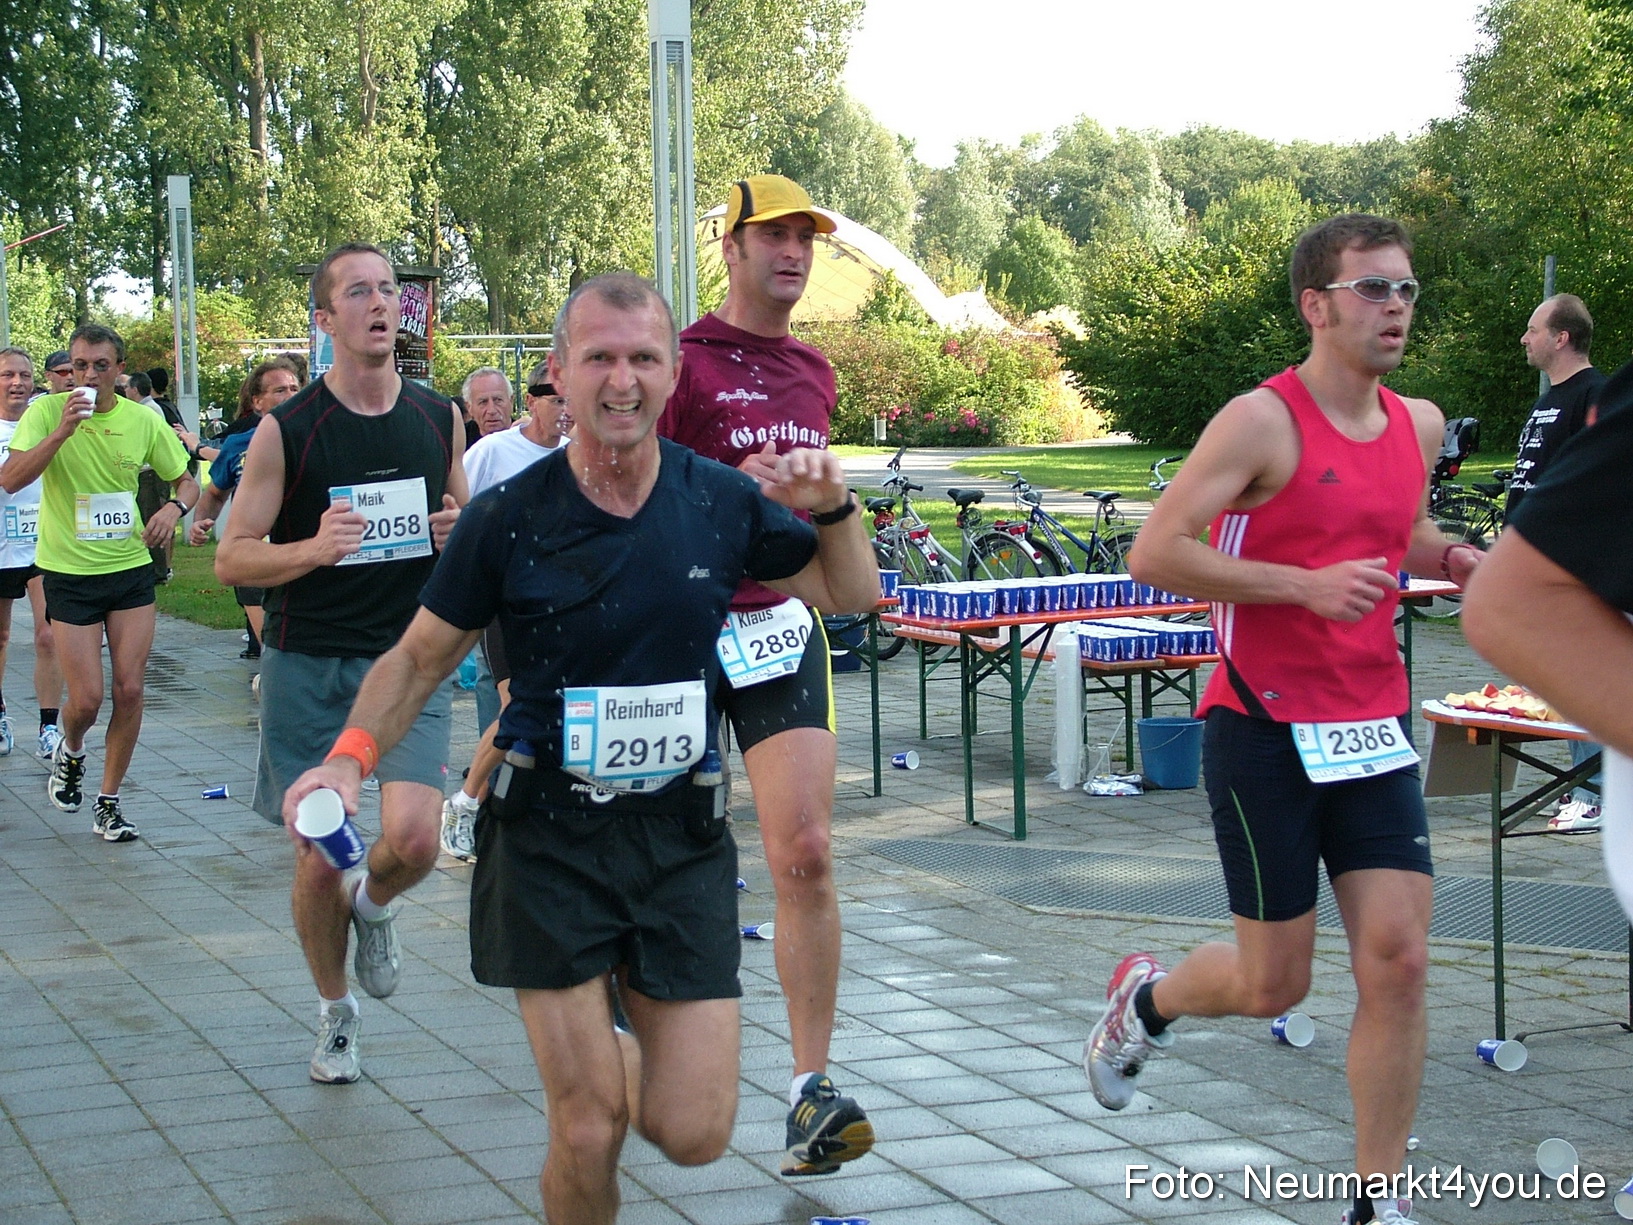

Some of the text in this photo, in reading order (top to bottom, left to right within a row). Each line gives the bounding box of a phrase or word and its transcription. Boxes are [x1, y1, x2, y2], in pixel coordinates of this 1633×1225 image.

[730, 420, 827, 449] Gasthaus
[357, 491, 385, 507] Maik
[94, 511, 130, 526] 1063
[363, 514, 421, 541] 2058
[394, 543, 430, 554] PFLEIDERER
[738, 609, 774, 629] Klaus
[722, 644, 730, 656] A
[749, 625, 809, 661] 2880
[605, 694, 684, 720] Reinhard
[571, 734, 580, 751] B
[1298, 728, 1306, 742] B
[1328, 723, 1396, 755] 2386
[605, 734, 693, 768] 2913
[570, 783, 594, 794] PRO
